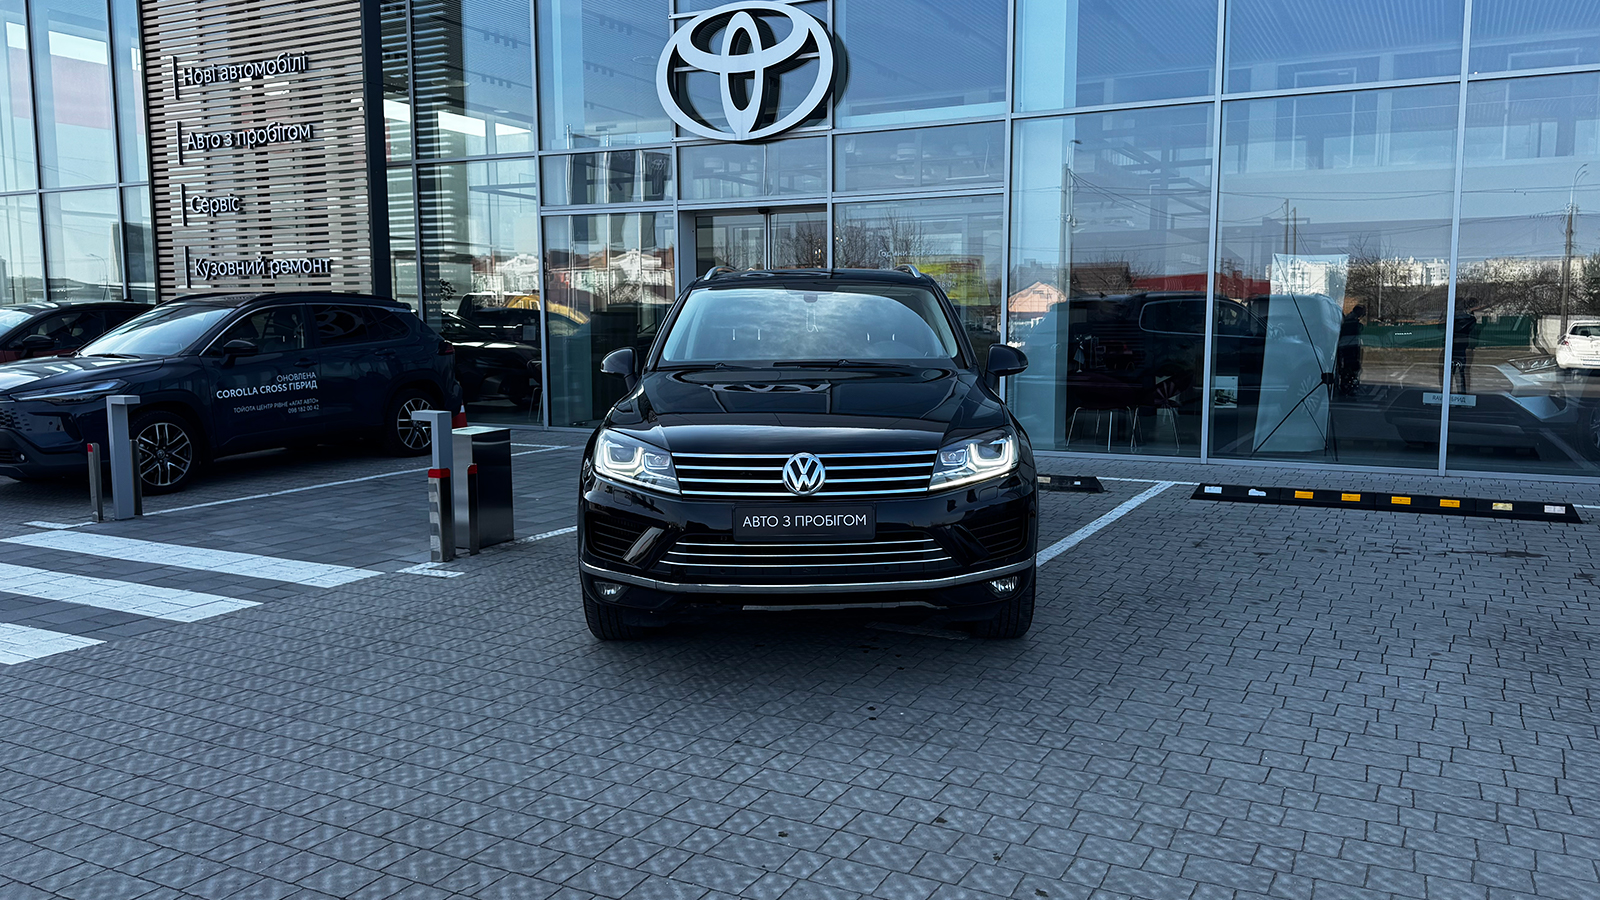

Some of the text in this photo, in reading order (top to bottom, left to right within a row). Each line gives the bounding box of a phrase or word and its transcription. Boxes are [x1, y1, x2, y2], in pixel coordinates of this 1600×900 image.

[182, 52, 308, 86] Нові автомобілі
[186, 122, 311, 150] Авто з пробігом
[190, 193, 241, 215] Сервіс
[194, 256, 332, 280] Кузовний ремонт
[277, 372, 316, 382] ОНОВЛЕНА
[217, 380, 317, 399] COROLLA CROSS ГІБРИД
[234, 405, 256, 413] ТОЙОТА
[257, 403, 273, 411] ЦЕНТР
[742, 514, 867, 528] АВТО З ПРОБІГОМ
